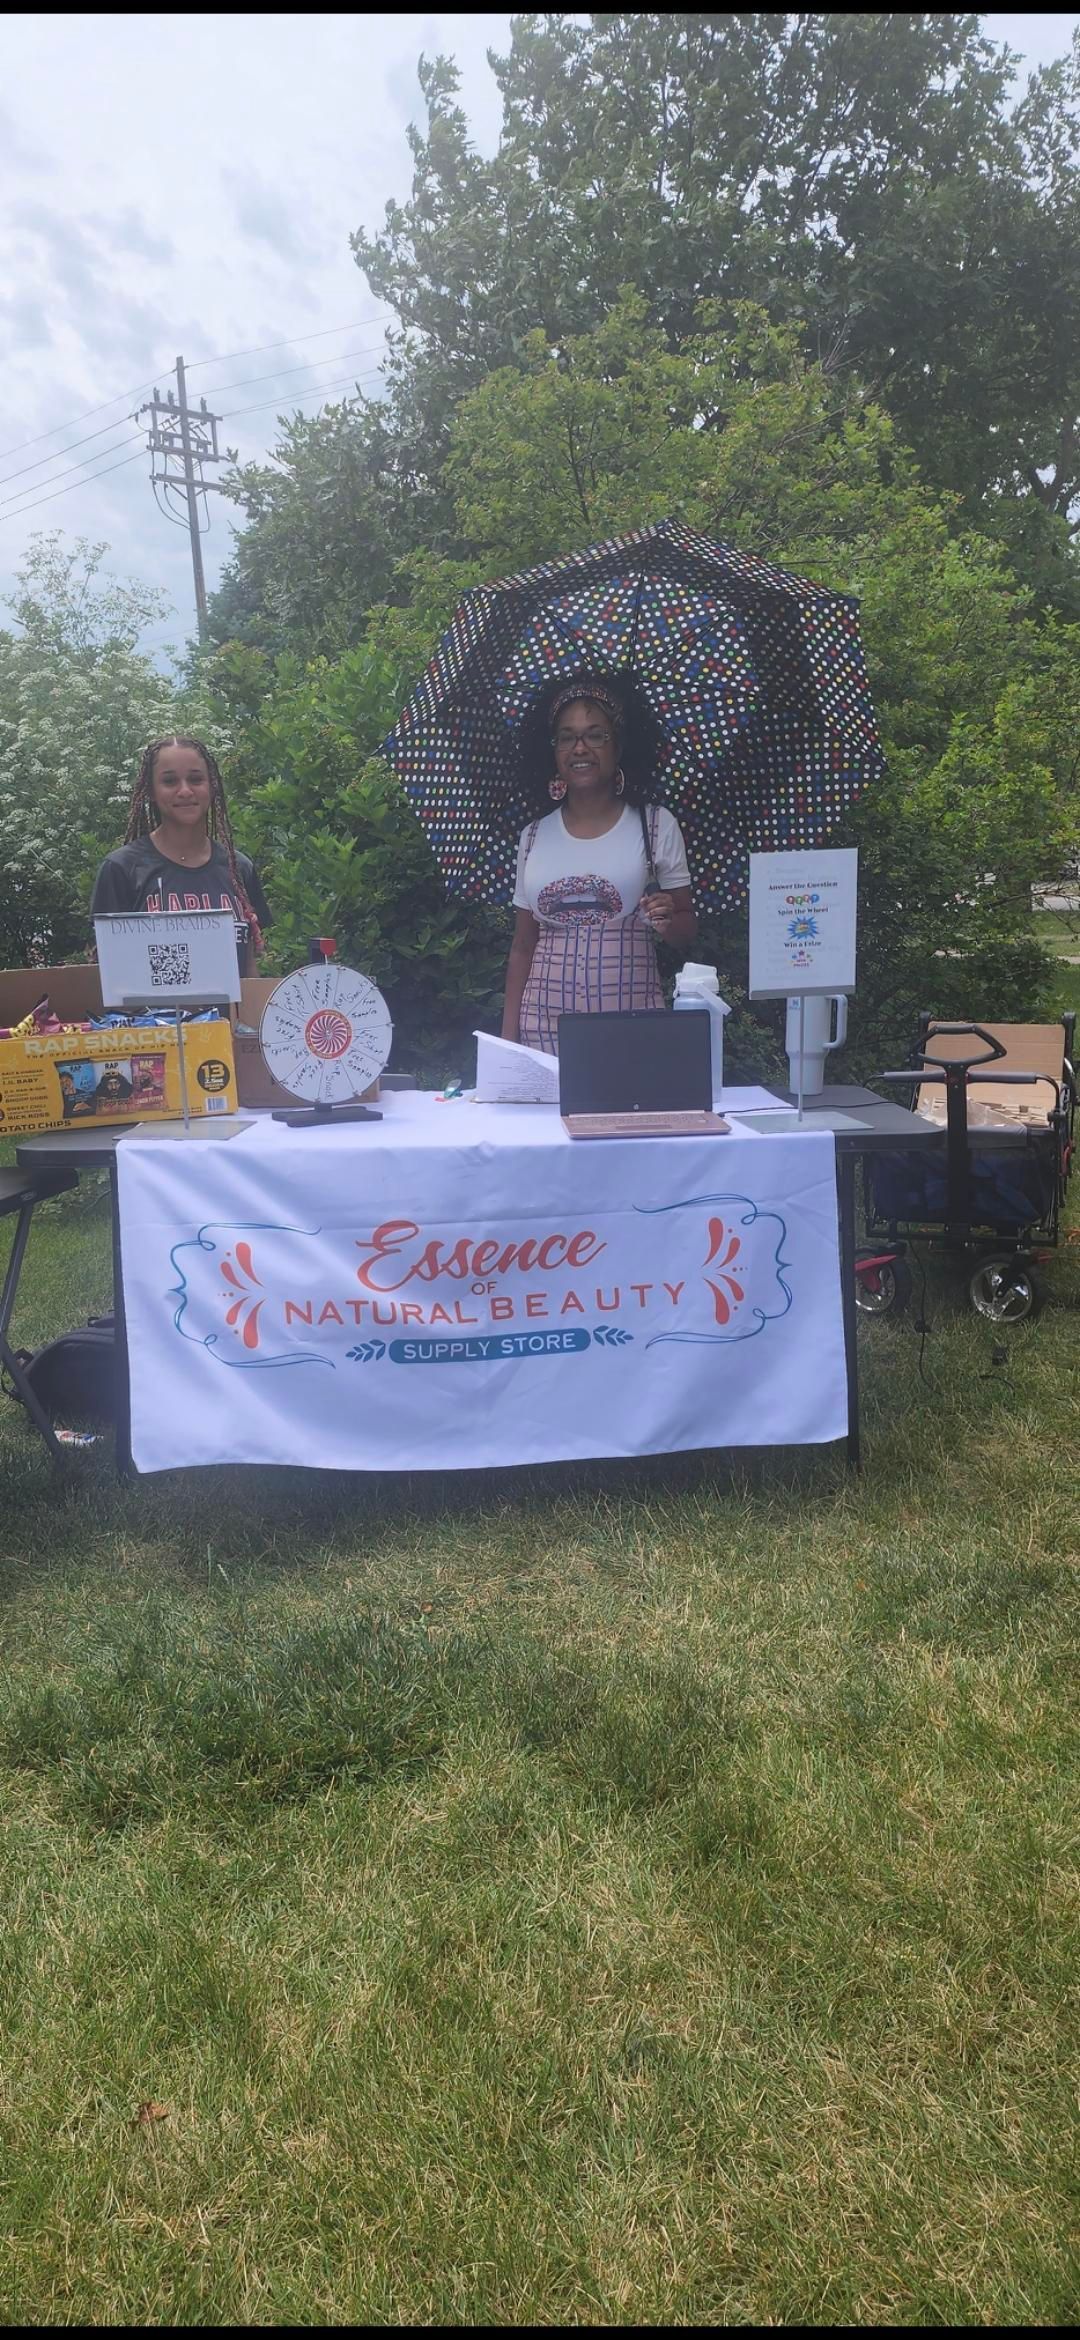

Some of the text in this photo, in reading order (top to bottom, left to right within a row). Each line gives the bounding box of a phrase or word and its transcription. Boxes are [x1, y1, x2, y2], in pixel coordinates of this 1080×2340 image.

[111, 915, 221, 934] DIVINE BRAIDS
[25, 1029, 188, 1055] RAP SNACKS
[201, 1064, 225, 1078] 13
[38, 1120, 71, 1128] CHIPS
[356, 1219, 608, 1292] Essence
[471, 1281, 497, 1295] OF
[284, 1281, 686, 1325] NATURAL BEAUTY
[403, 1333, 577, 1359] SUPPLY STORE
